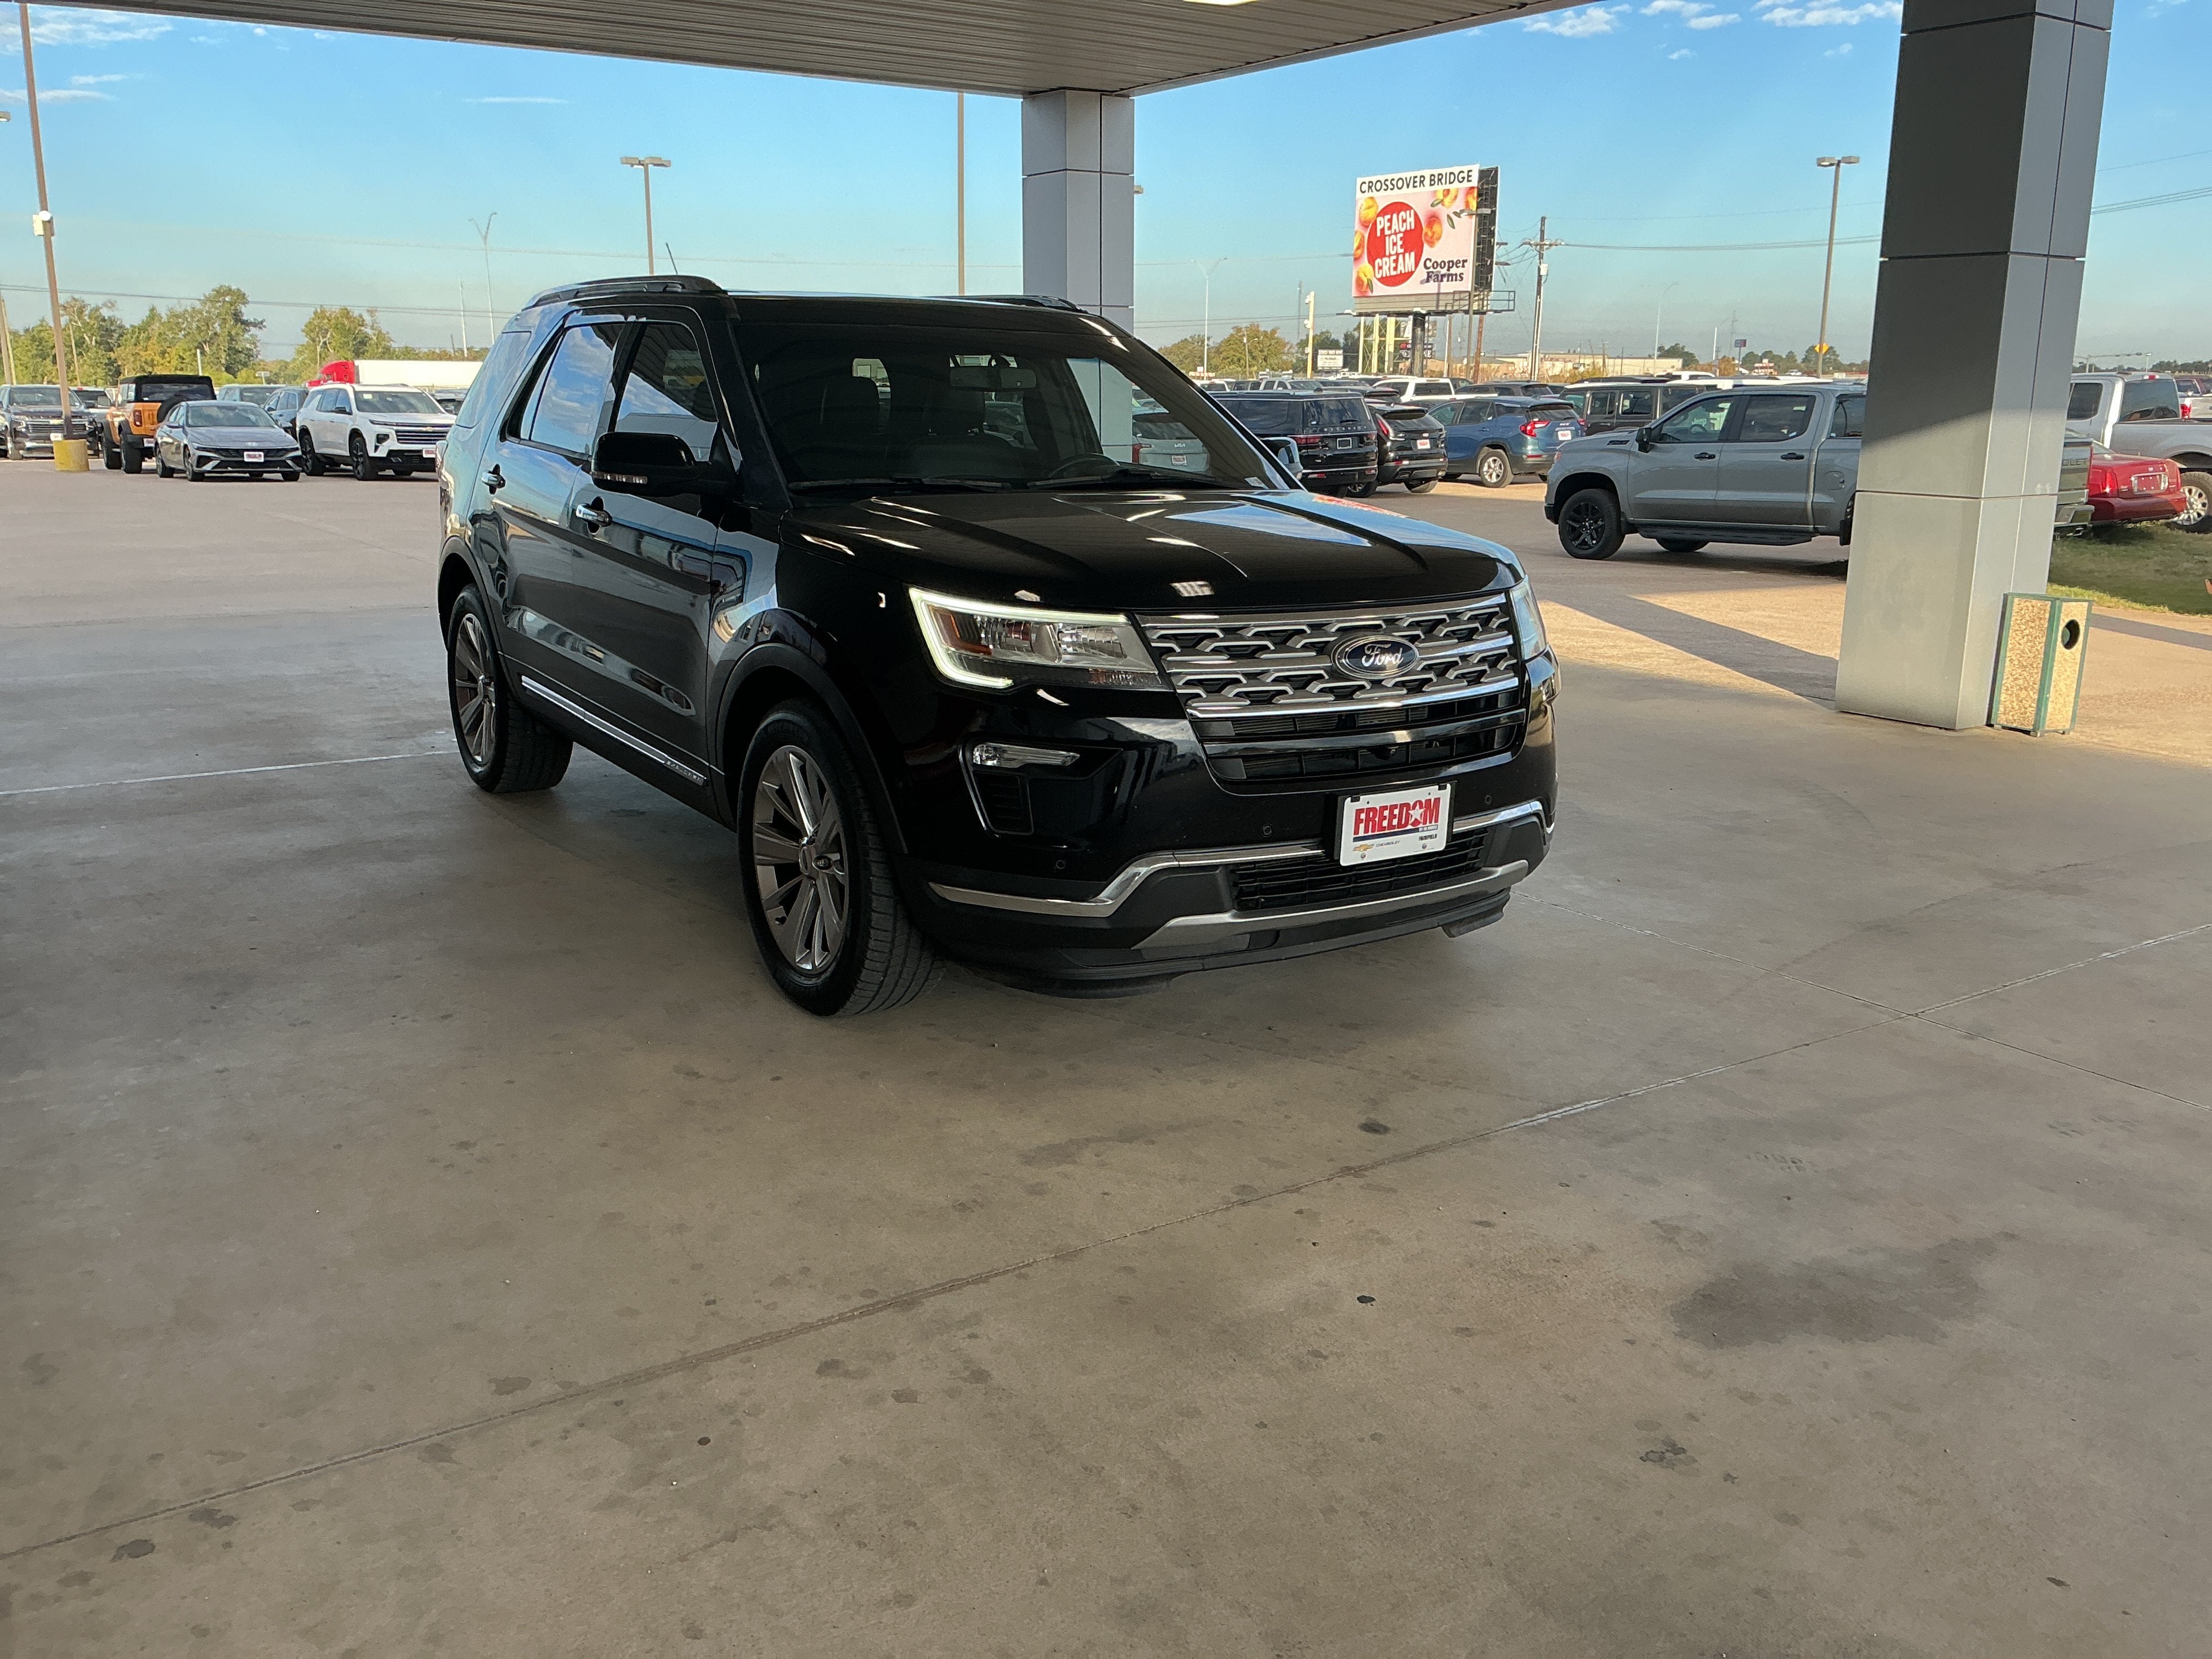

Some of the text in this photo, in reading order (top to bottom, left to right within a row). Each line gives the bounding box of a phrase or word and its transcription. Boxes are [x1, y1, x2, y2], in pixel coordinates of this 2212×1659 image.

[1359, 169, 1473, 194] CROSSOVER BRIDGE
[1376, 209, 1415, 237] PEACH
[1385, 233, 1404, 256] ICE
[1374, 251, 1415, 278] CREAM
[1423, 257, 1468, 272] Cooper
[1426, 271, 1464, 284] Farms
[1362, 644, 1404, 667] Ford
[1353, 797, 1441, 836] FREEDOM
